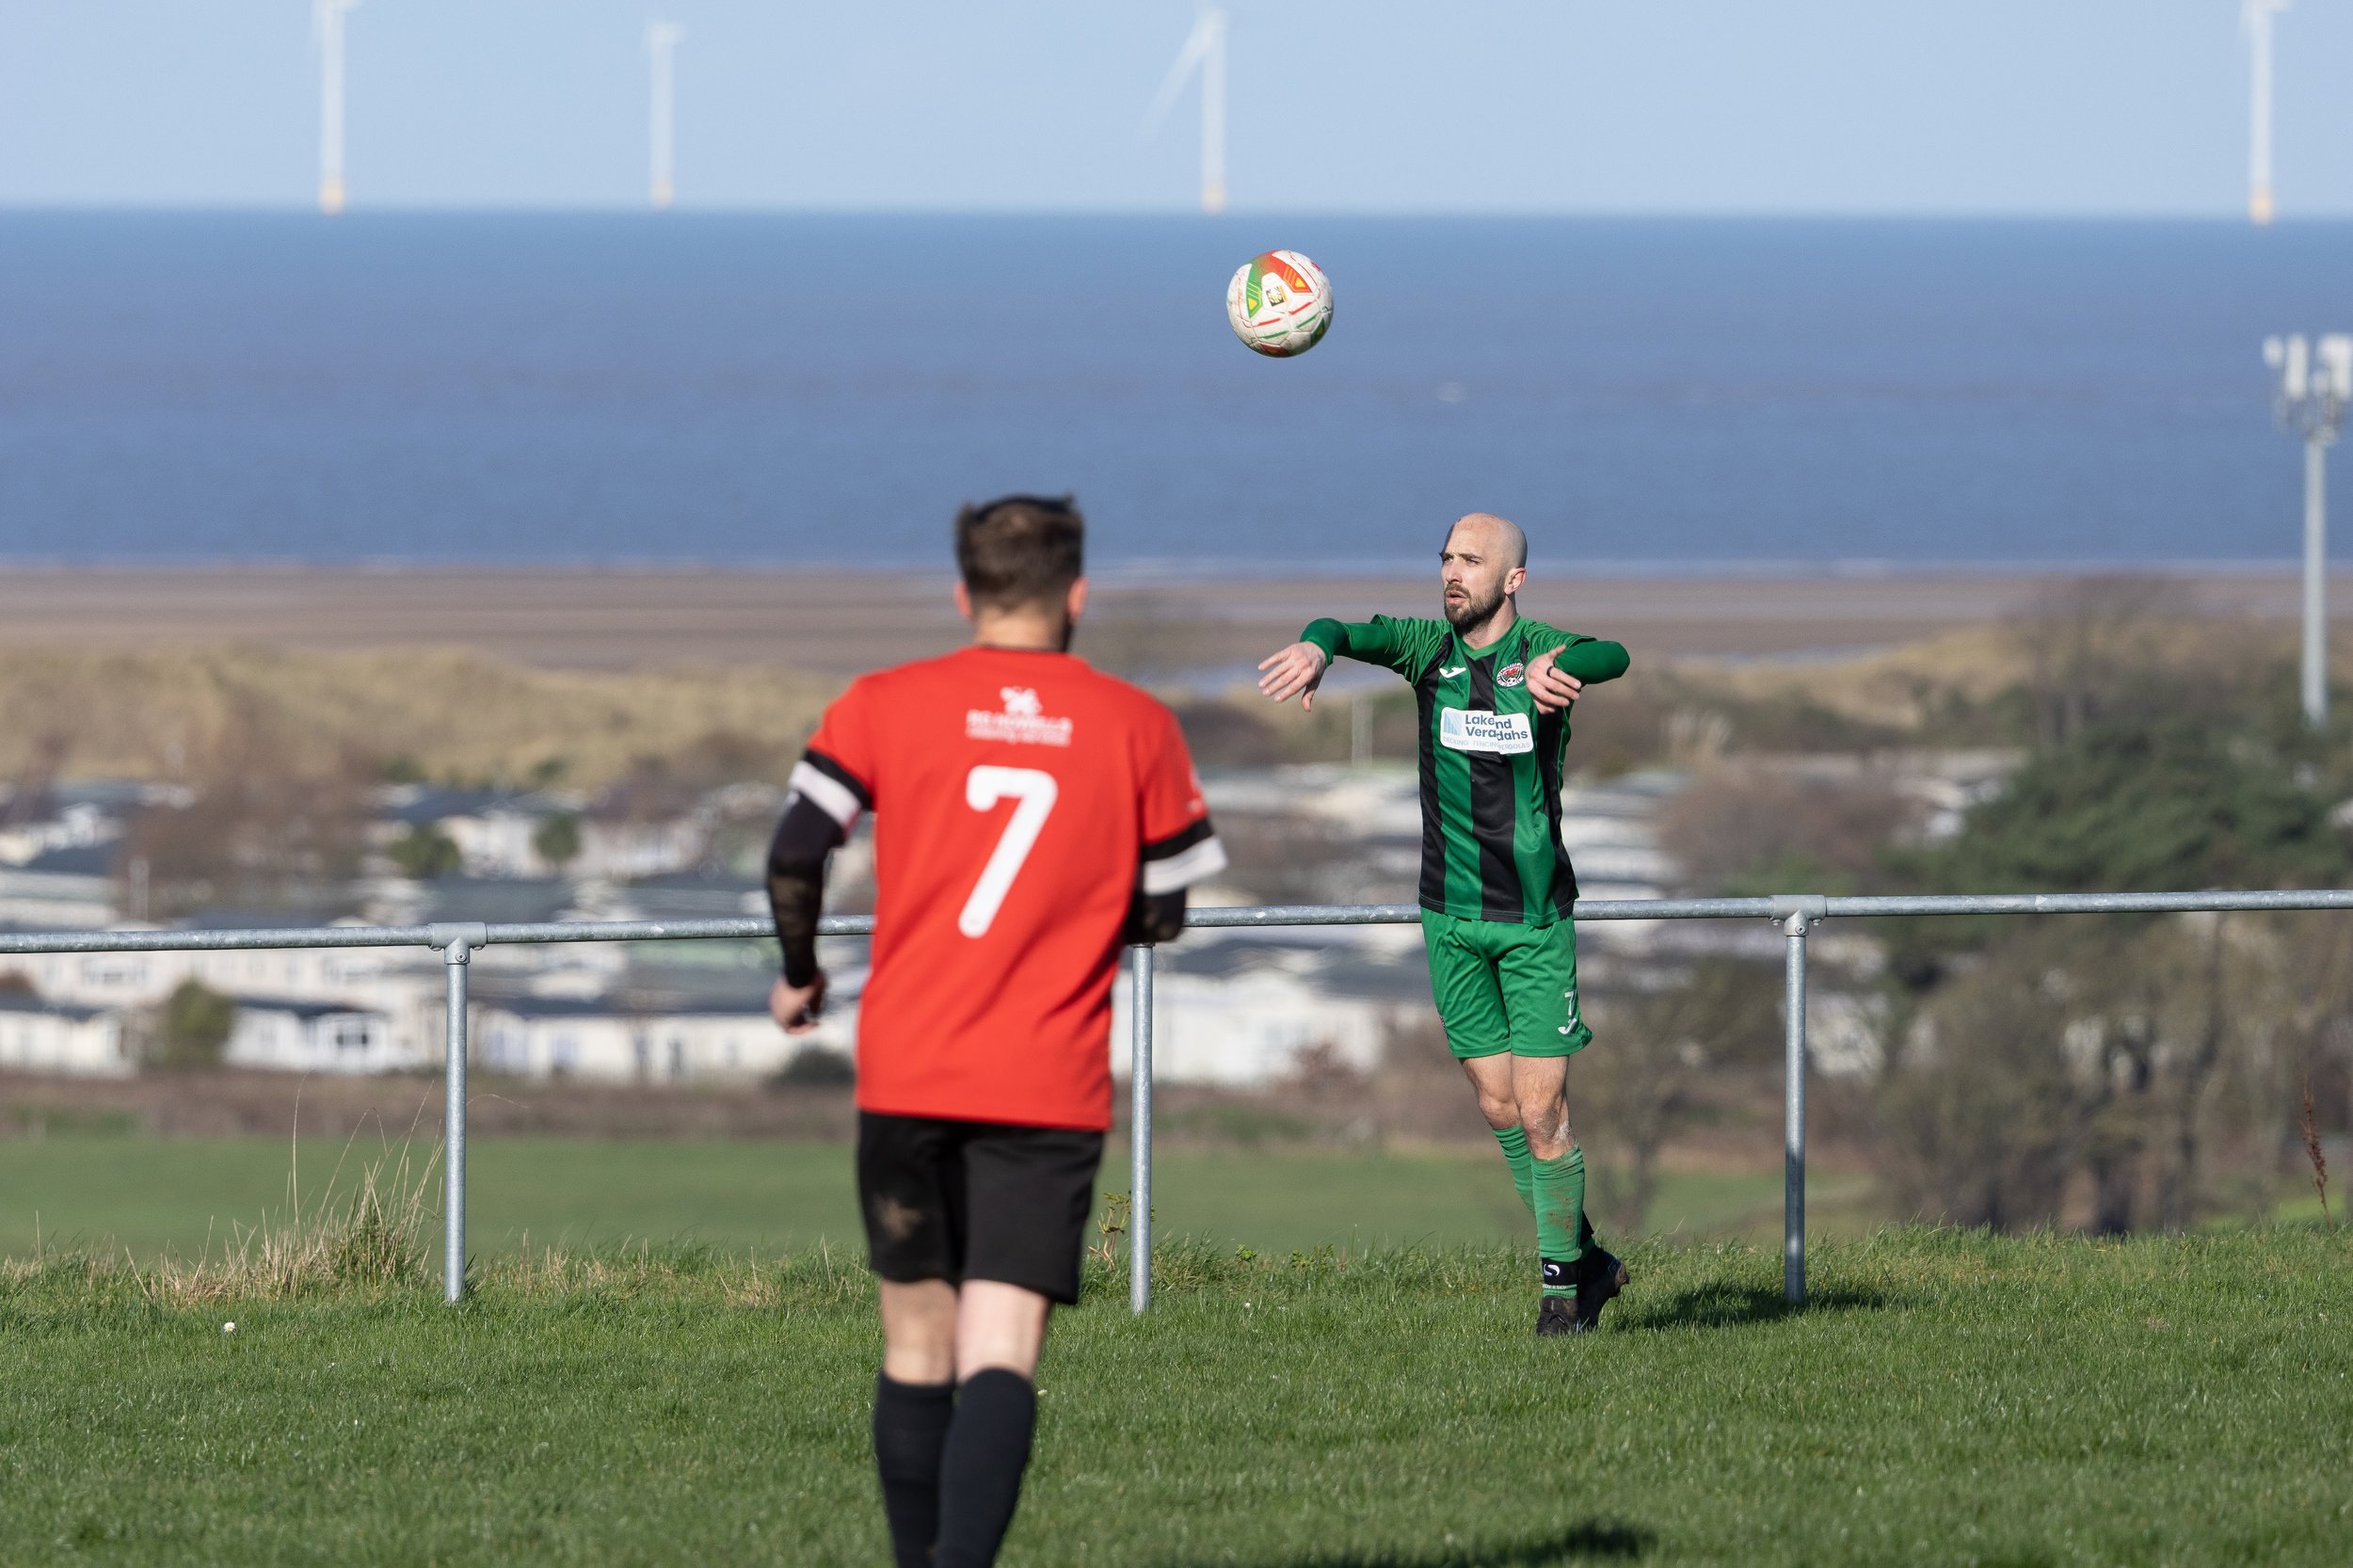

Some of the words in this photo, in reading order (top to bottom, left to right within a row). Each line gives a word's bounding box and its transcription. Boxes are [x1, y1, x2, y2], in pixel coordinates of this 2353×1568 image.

[1465, 727, 1529, 741] Veradahs
[958, 764, 1059, 939] 7
[1564, 991, 1575, 1016] 7
